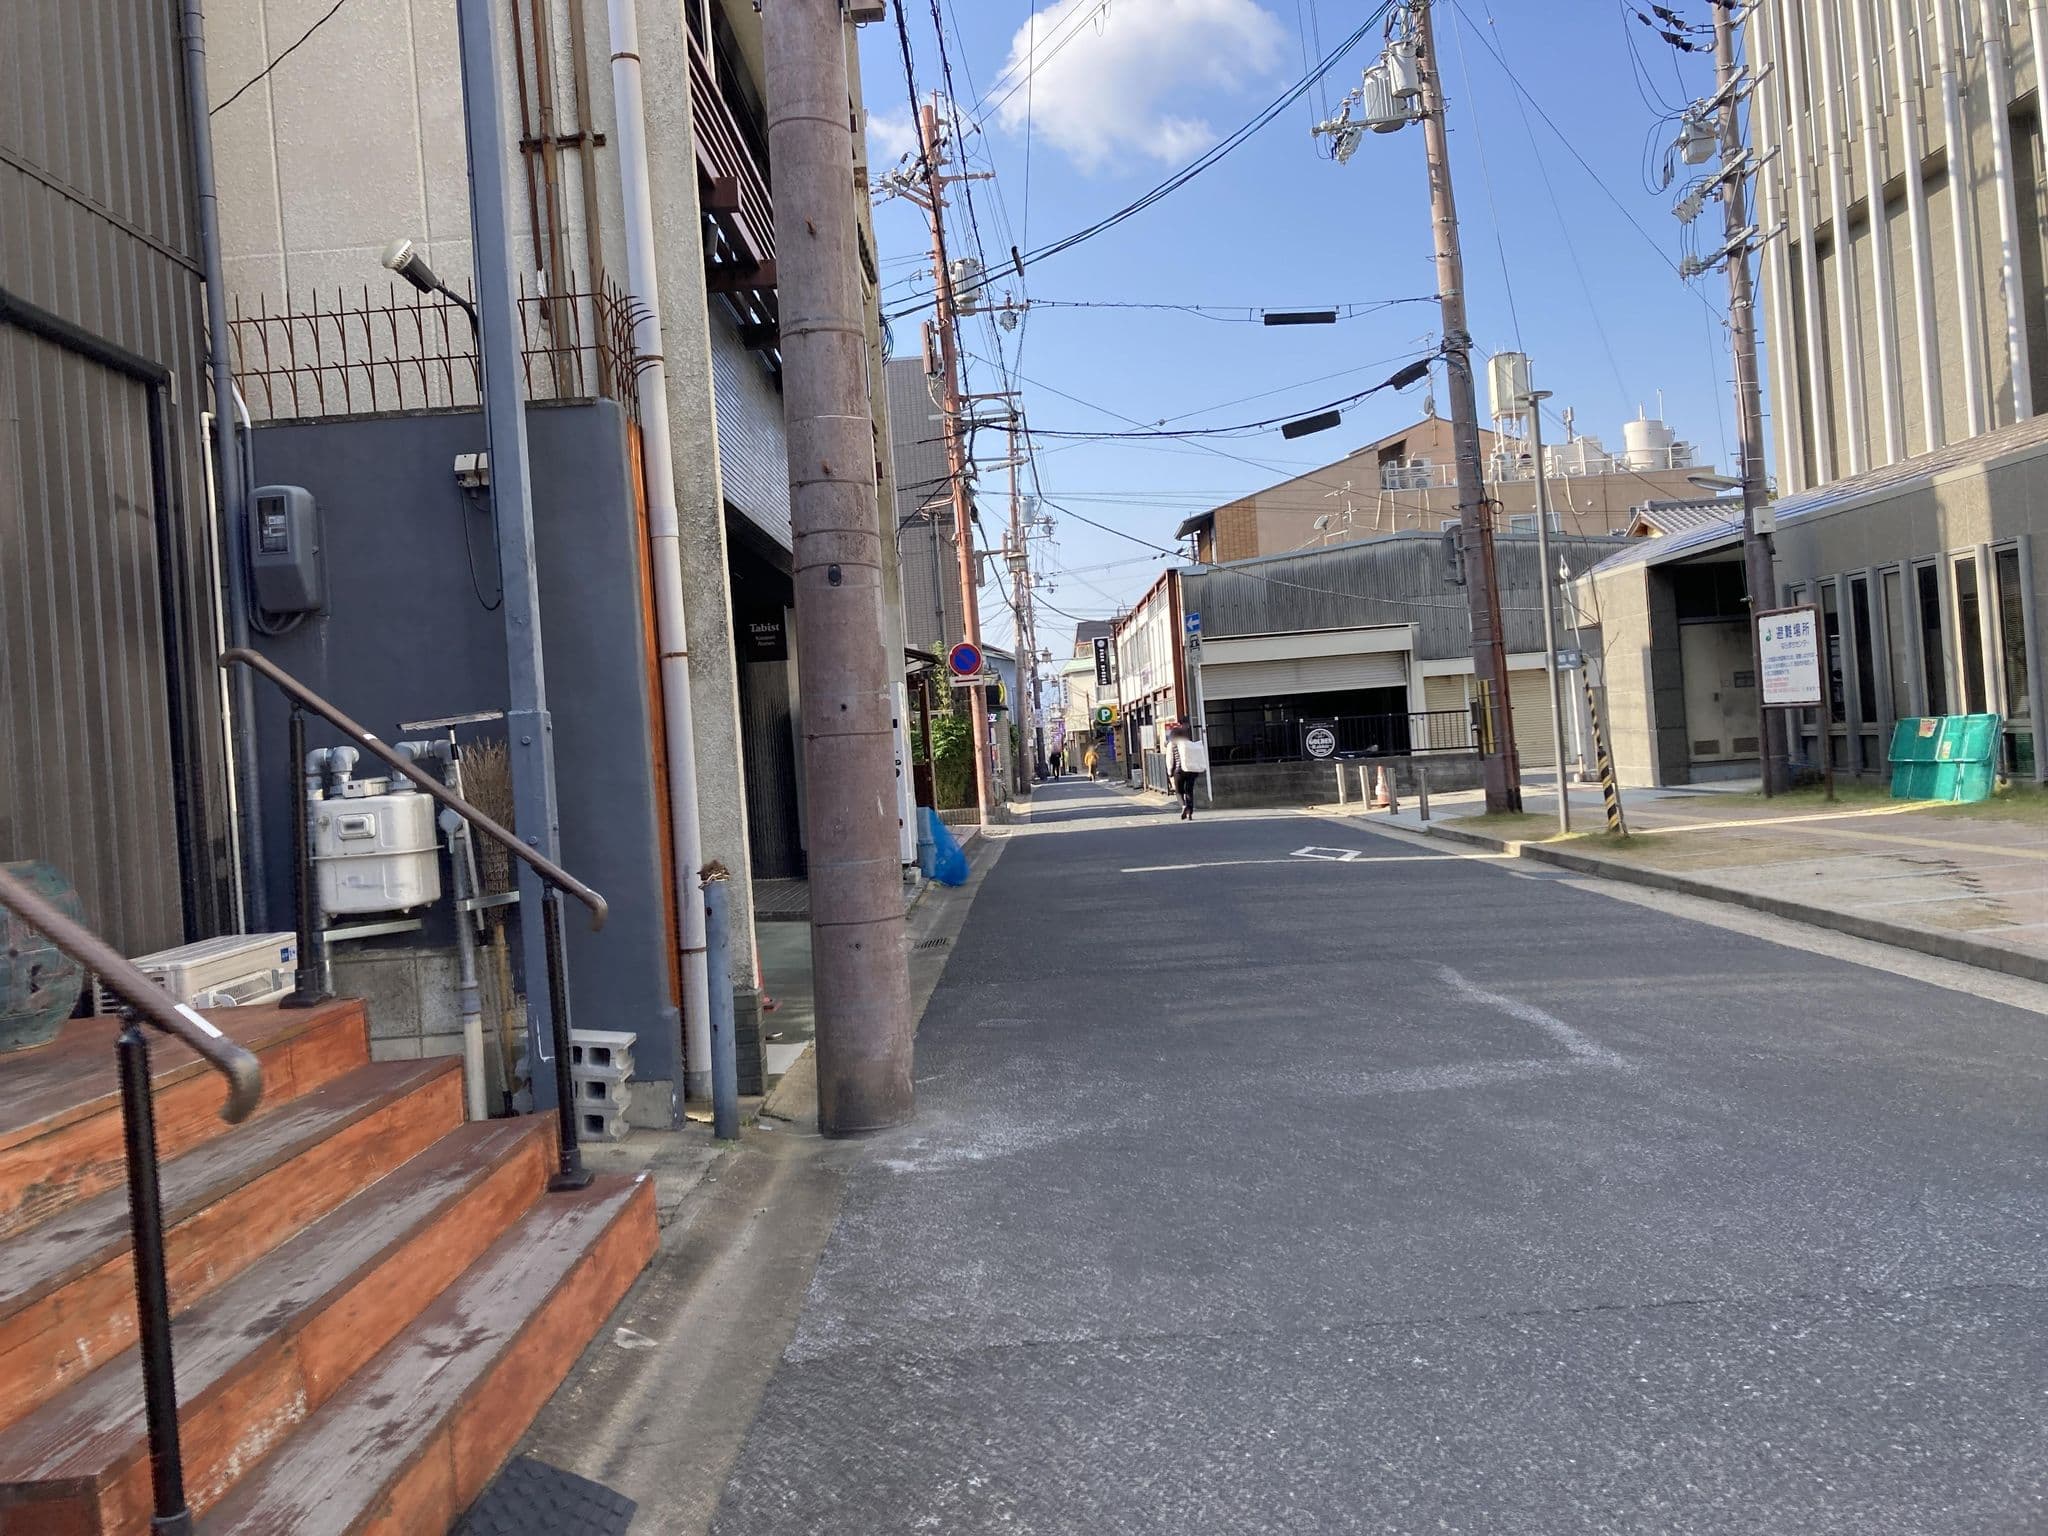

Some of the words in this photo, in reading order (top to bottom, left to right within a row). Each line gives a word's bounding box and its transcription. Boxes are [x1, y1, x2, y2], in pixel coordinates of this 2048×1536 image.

[749, 622, 779, 632] Tabist
[1776, 622, 1809, 639] 避難場所
[1101, 709, 1110, 720] P
